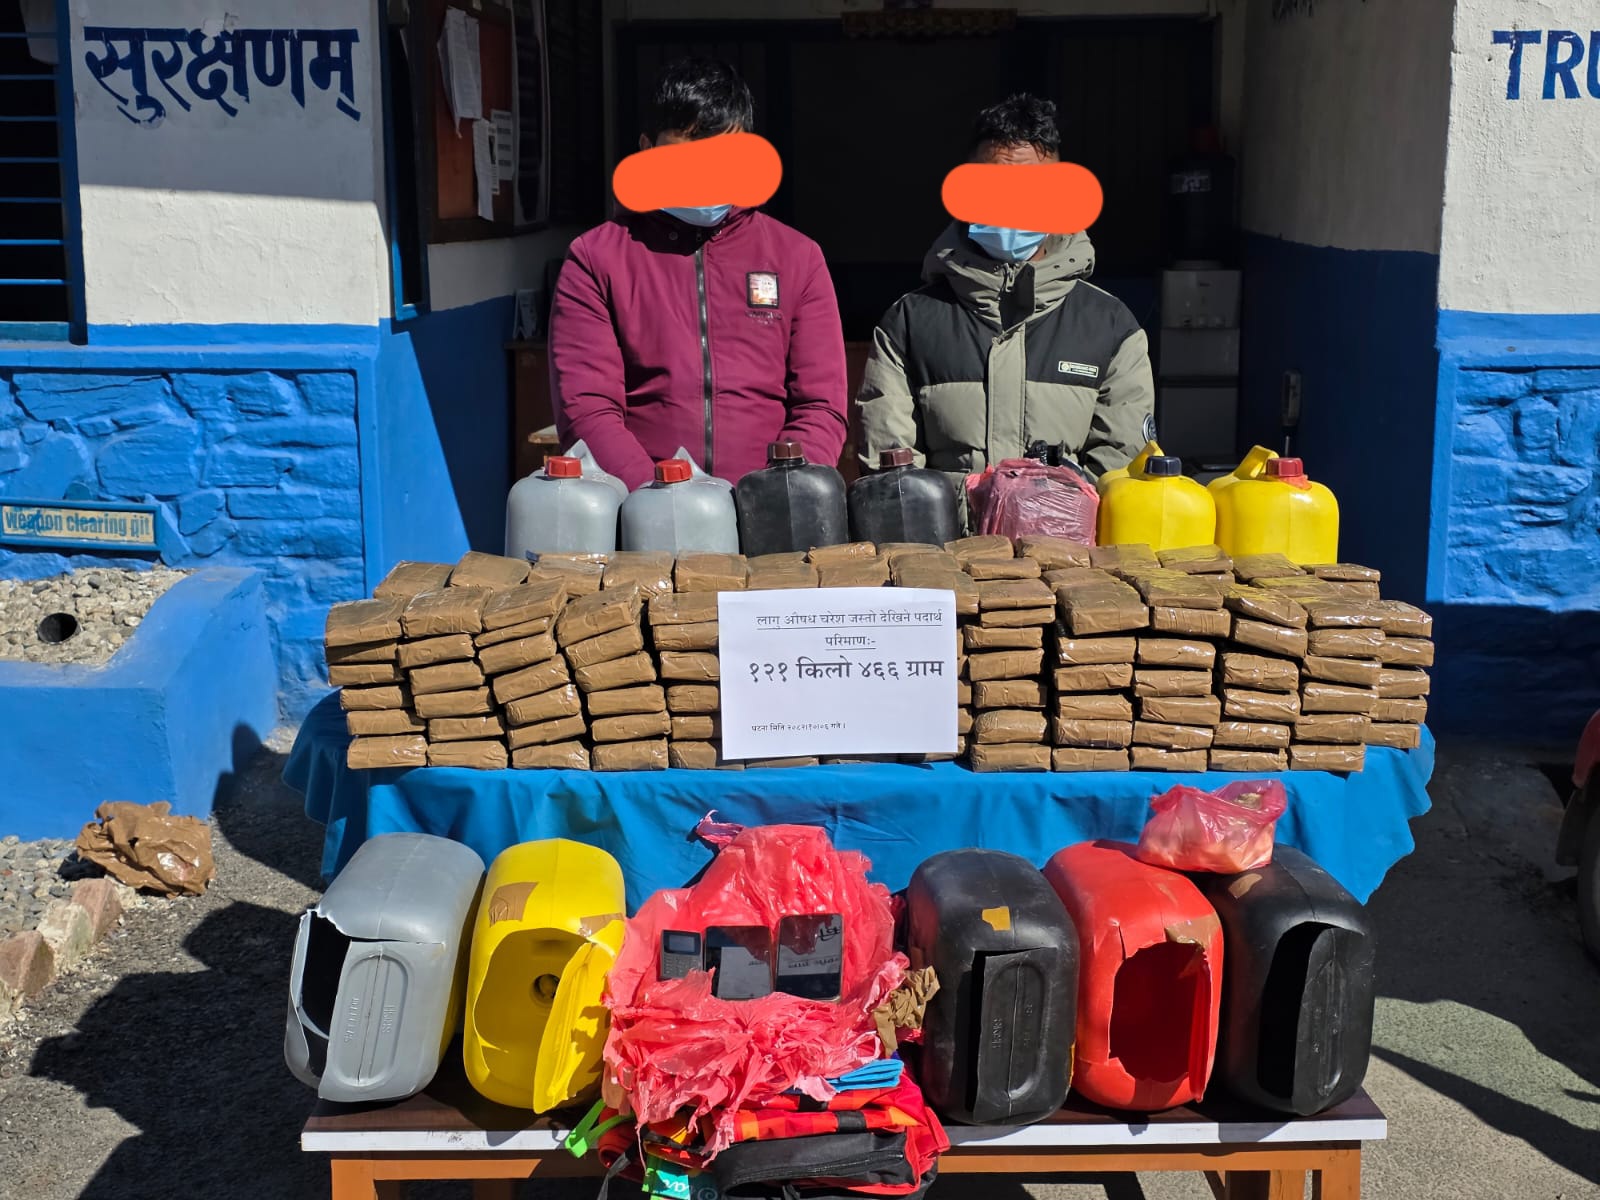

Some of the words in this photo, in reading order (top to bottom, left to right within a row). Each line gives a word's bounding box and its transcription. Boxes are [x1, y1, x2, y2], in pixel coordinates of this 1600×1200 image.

[84, 26, 361, 124] सुरक्षणम्
[66, 513, 126, 536] clearing
[130, 514, 150, 538] pit
[784, 611, 818, 625] औषध
[819, 610, 846, 624] चरेश
[847, 609, 877, 624] जस्तो
[879, 608, 911, 623] देखिने
[913, 608, 943, 622] पदार्थ
[749, 660, 789, 683] १२१
[795, 655, 852, 680] किलो
[857, 661, 900, 681] ४६६
[905, 659, 945, 677] ग्राम
